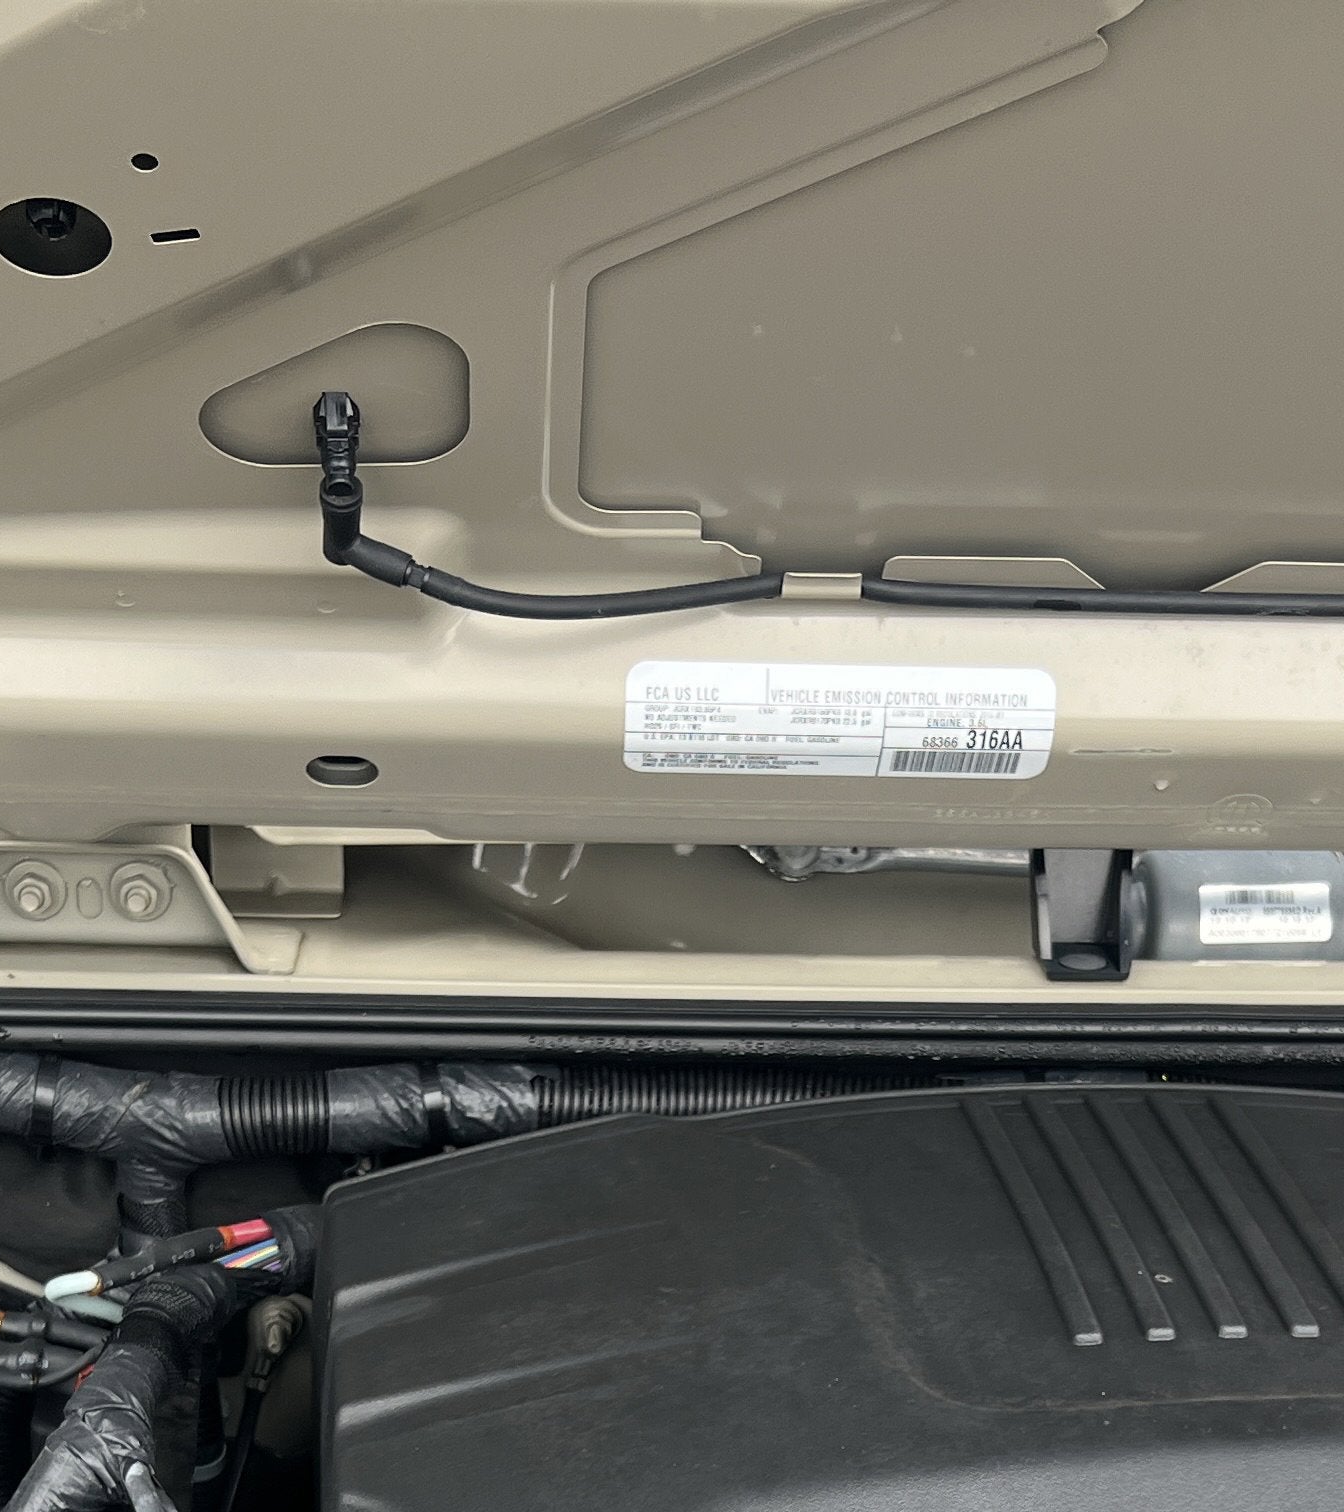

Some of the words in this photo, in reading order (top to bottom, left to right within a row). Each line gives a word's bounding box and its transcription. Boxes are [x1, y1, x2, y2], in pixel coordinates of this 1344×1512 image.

[646, 687, 669, 701] FCA
[675, 687, 691, 701] US
[696, 687, 720, 701] LLC
[770, 689, 819, 703] VEHICLE
[824, 690, 881, 704] EMISSION
[886, 692, 940, 706] CONTROL
[945, 692, 1028, 708] INFORMATION
[922, 736, 959, 748] 68366
[966, 729, 1023, 751] 316AA
